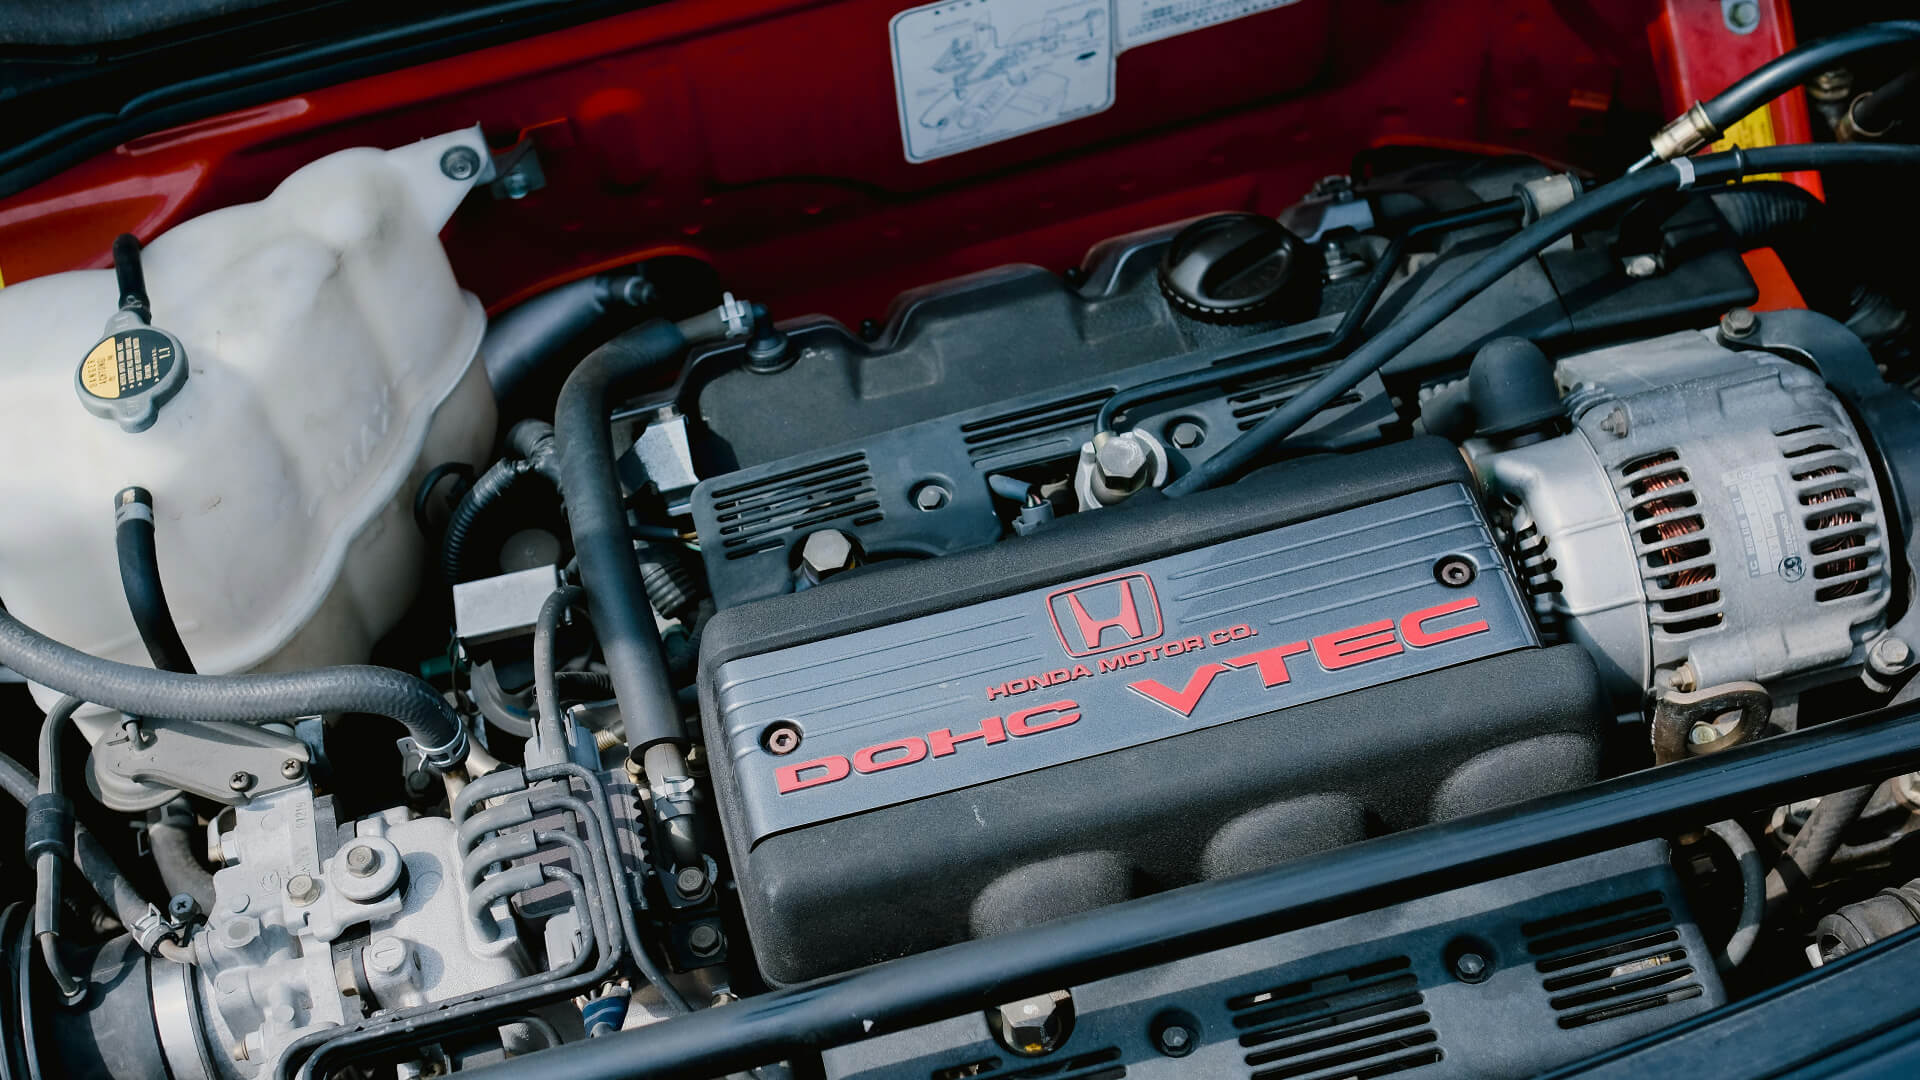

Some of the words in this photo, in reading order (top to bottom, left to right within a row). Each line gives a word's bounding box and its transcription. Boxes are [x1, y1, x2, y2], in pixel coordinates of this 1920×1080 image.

[775, 699, 1082, 794] DOHC
[1126, 596, 1489, 717] VTEC
[986, 664, 1093, 701] HONDA
[1098, 635, 1205, 673] MOTOR
[1208, 623, 1259, 645] CO.
